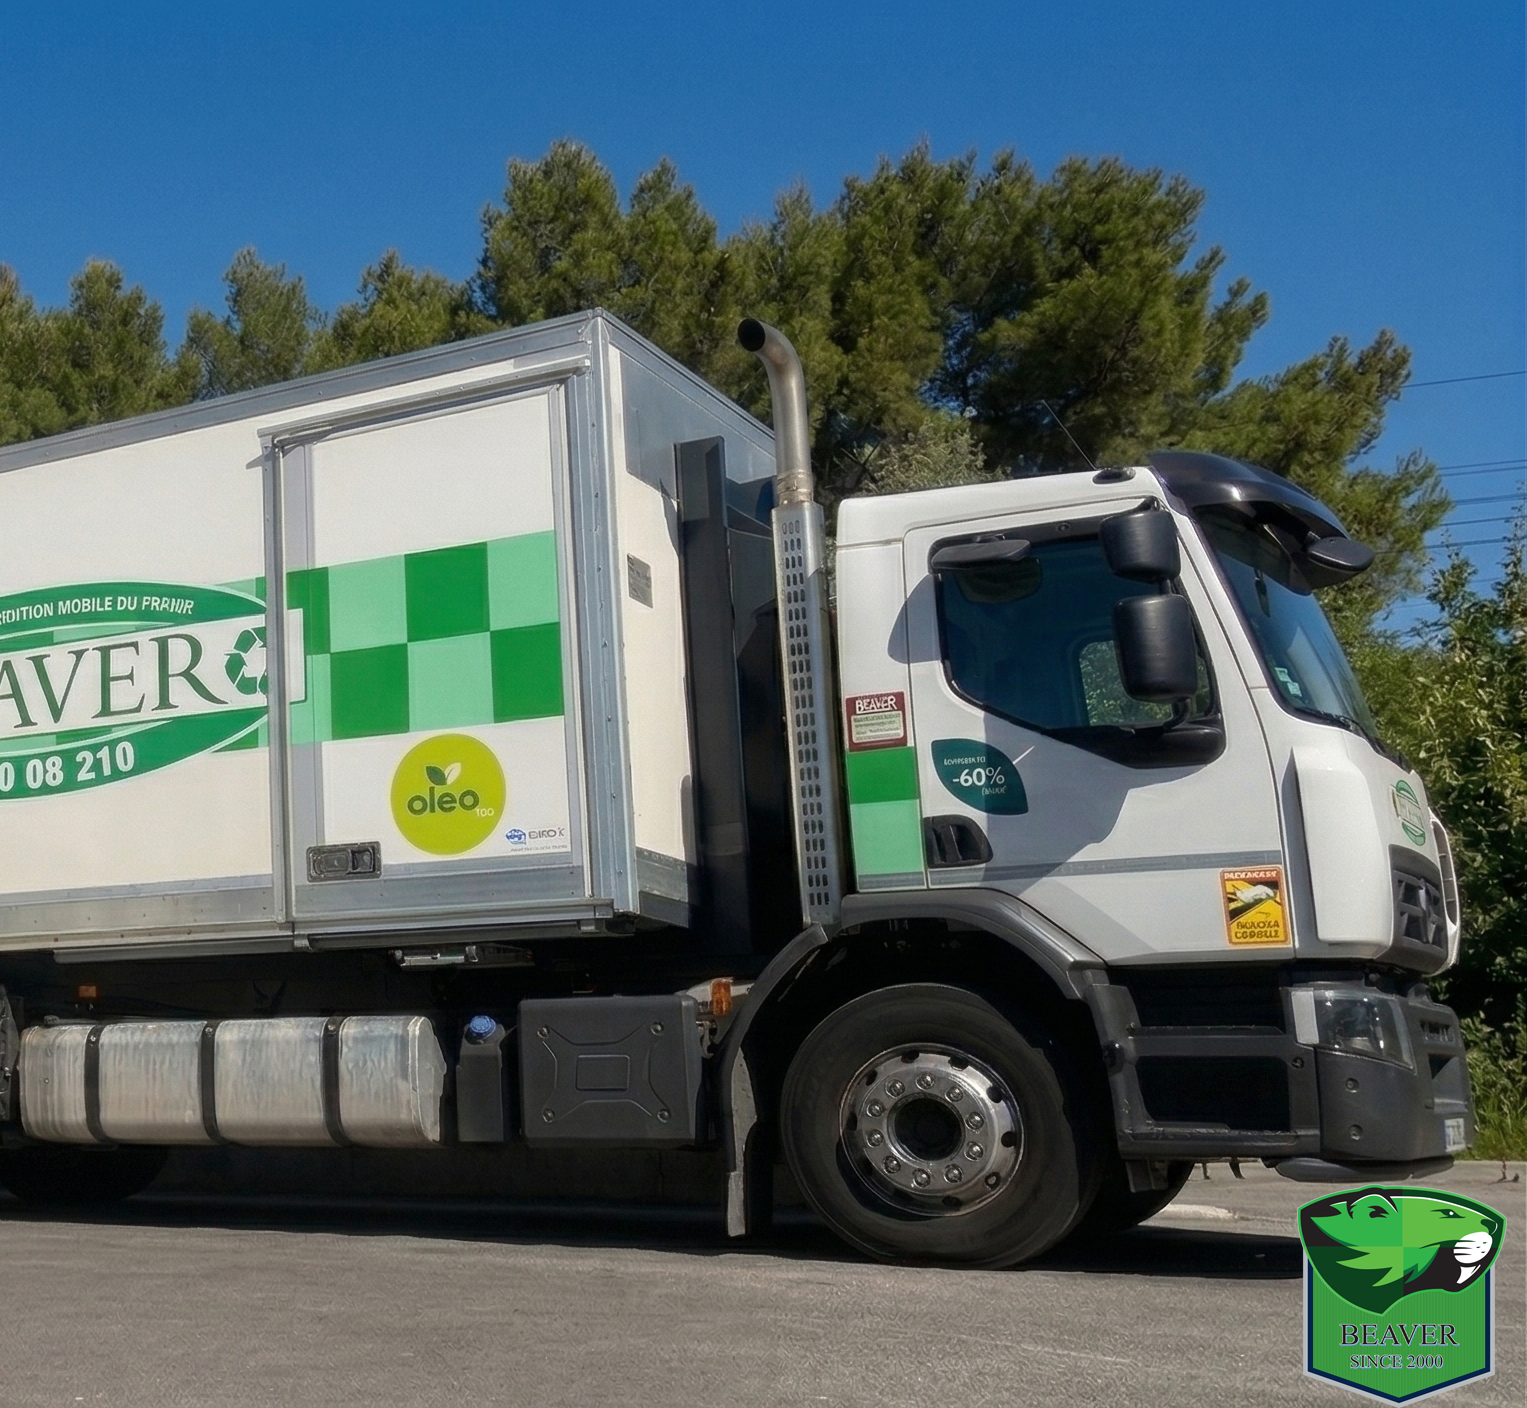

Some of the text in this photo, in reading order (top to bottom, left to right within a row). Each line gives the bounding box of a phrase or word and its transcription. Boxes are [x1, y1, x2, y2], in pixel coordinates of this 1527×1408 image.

[58, 597, 113, 615] MOBILE
[117, 596, 138, 610] DU
[855, 695, 898, 714] BEAVER
[25, 755, 64, 789] 08
[76, 741, 135, 782] 210
[952, 766, 1005, 787] -60%
[407, 786, 480, 816] oleo
[476, 807, 495, 817] 100
